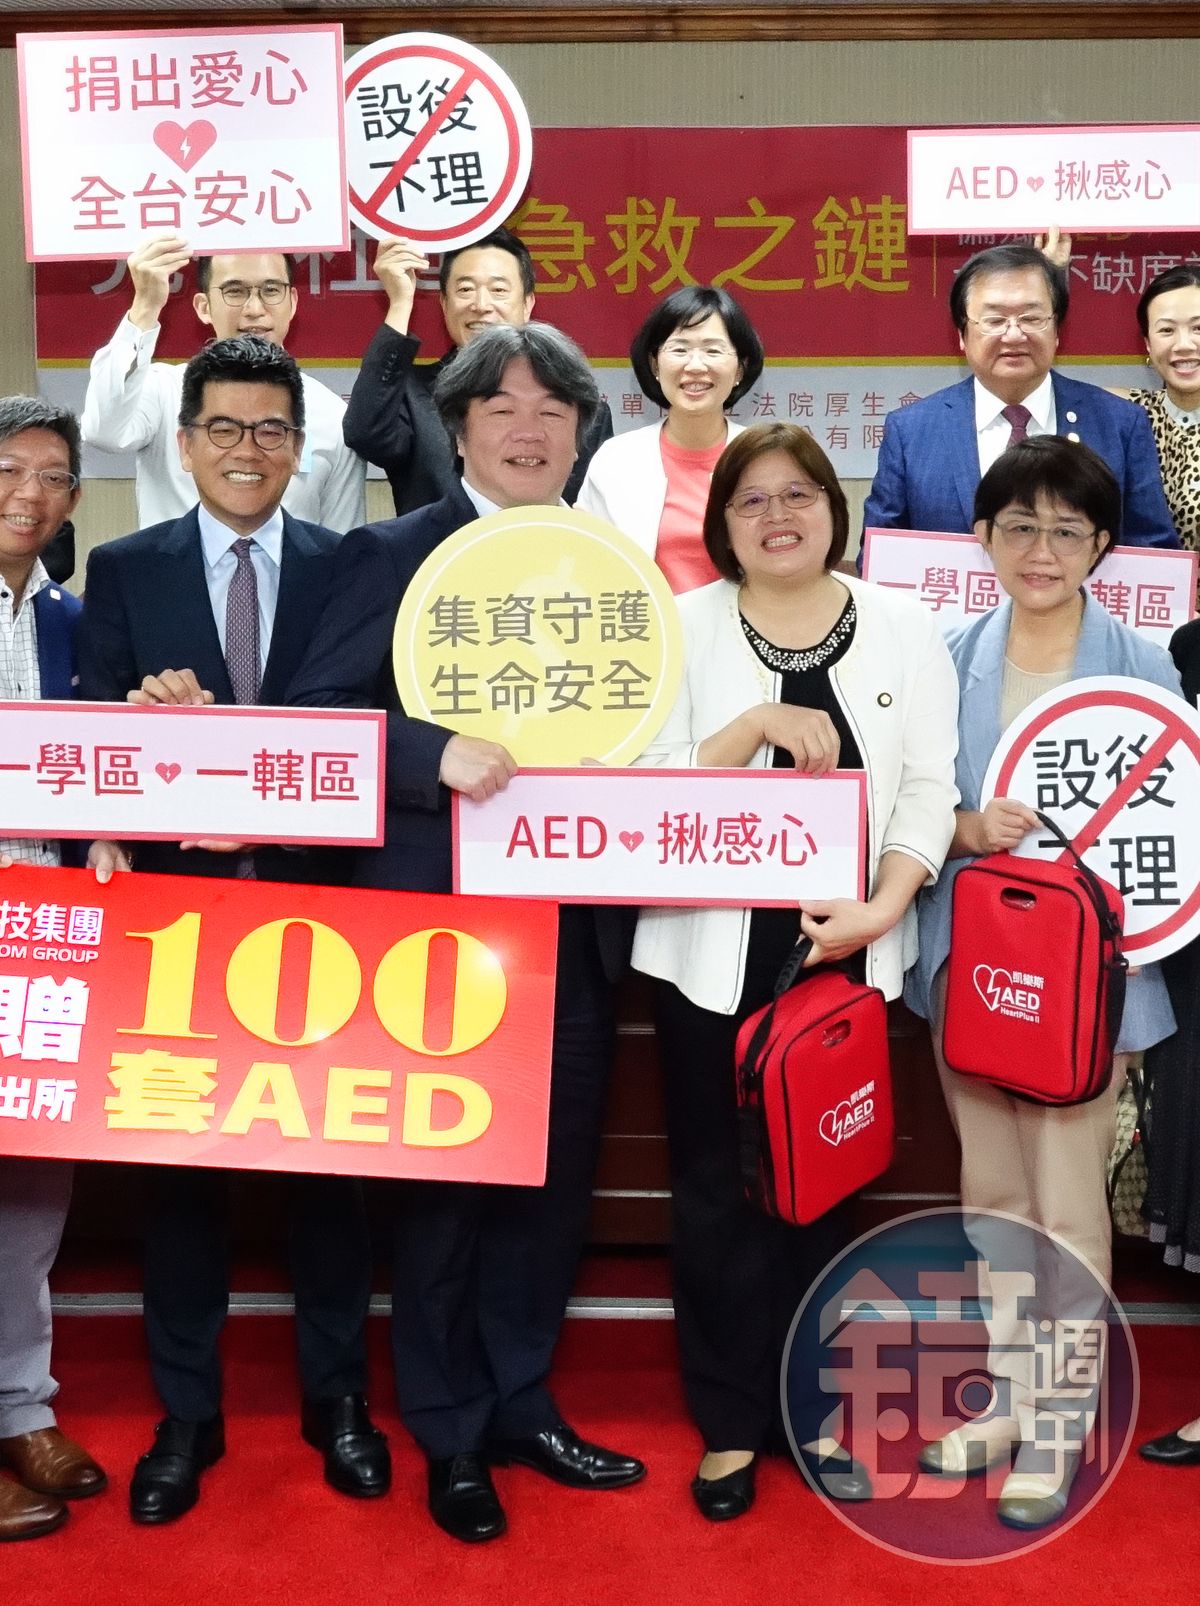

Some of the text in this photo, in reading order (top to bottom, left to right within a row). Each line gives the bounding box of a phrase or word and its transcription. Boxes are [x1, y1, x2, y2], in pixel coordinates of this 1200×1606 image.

[64, 49, 309, 112] 捐出愛心
[356, 76, 477, 142] 設後
[70, 169, 313, 230] 全台安心
[369, 151, 489, 213] 不理
[946, 159, 1172, 201] AED 揪感心
[504, 195, 910, 294] 急救之鏈
[427, 589, 652, 648] 集資守護
[430, 659, 653, 716] 生命安全
[196, 748, 360, 802] 一轄區
[1033, 733, 1176, 811] 設後
[505, 810, 819, 866] AED 揪感心
[32, 946, 99, 963] GROUP
[116, 911, 507, 1057] 100
[1001, 987, 1040, 1010] AED
[103, 1049, 493, 1148] 套AED
[843, 1099, 873, 1130] AED
